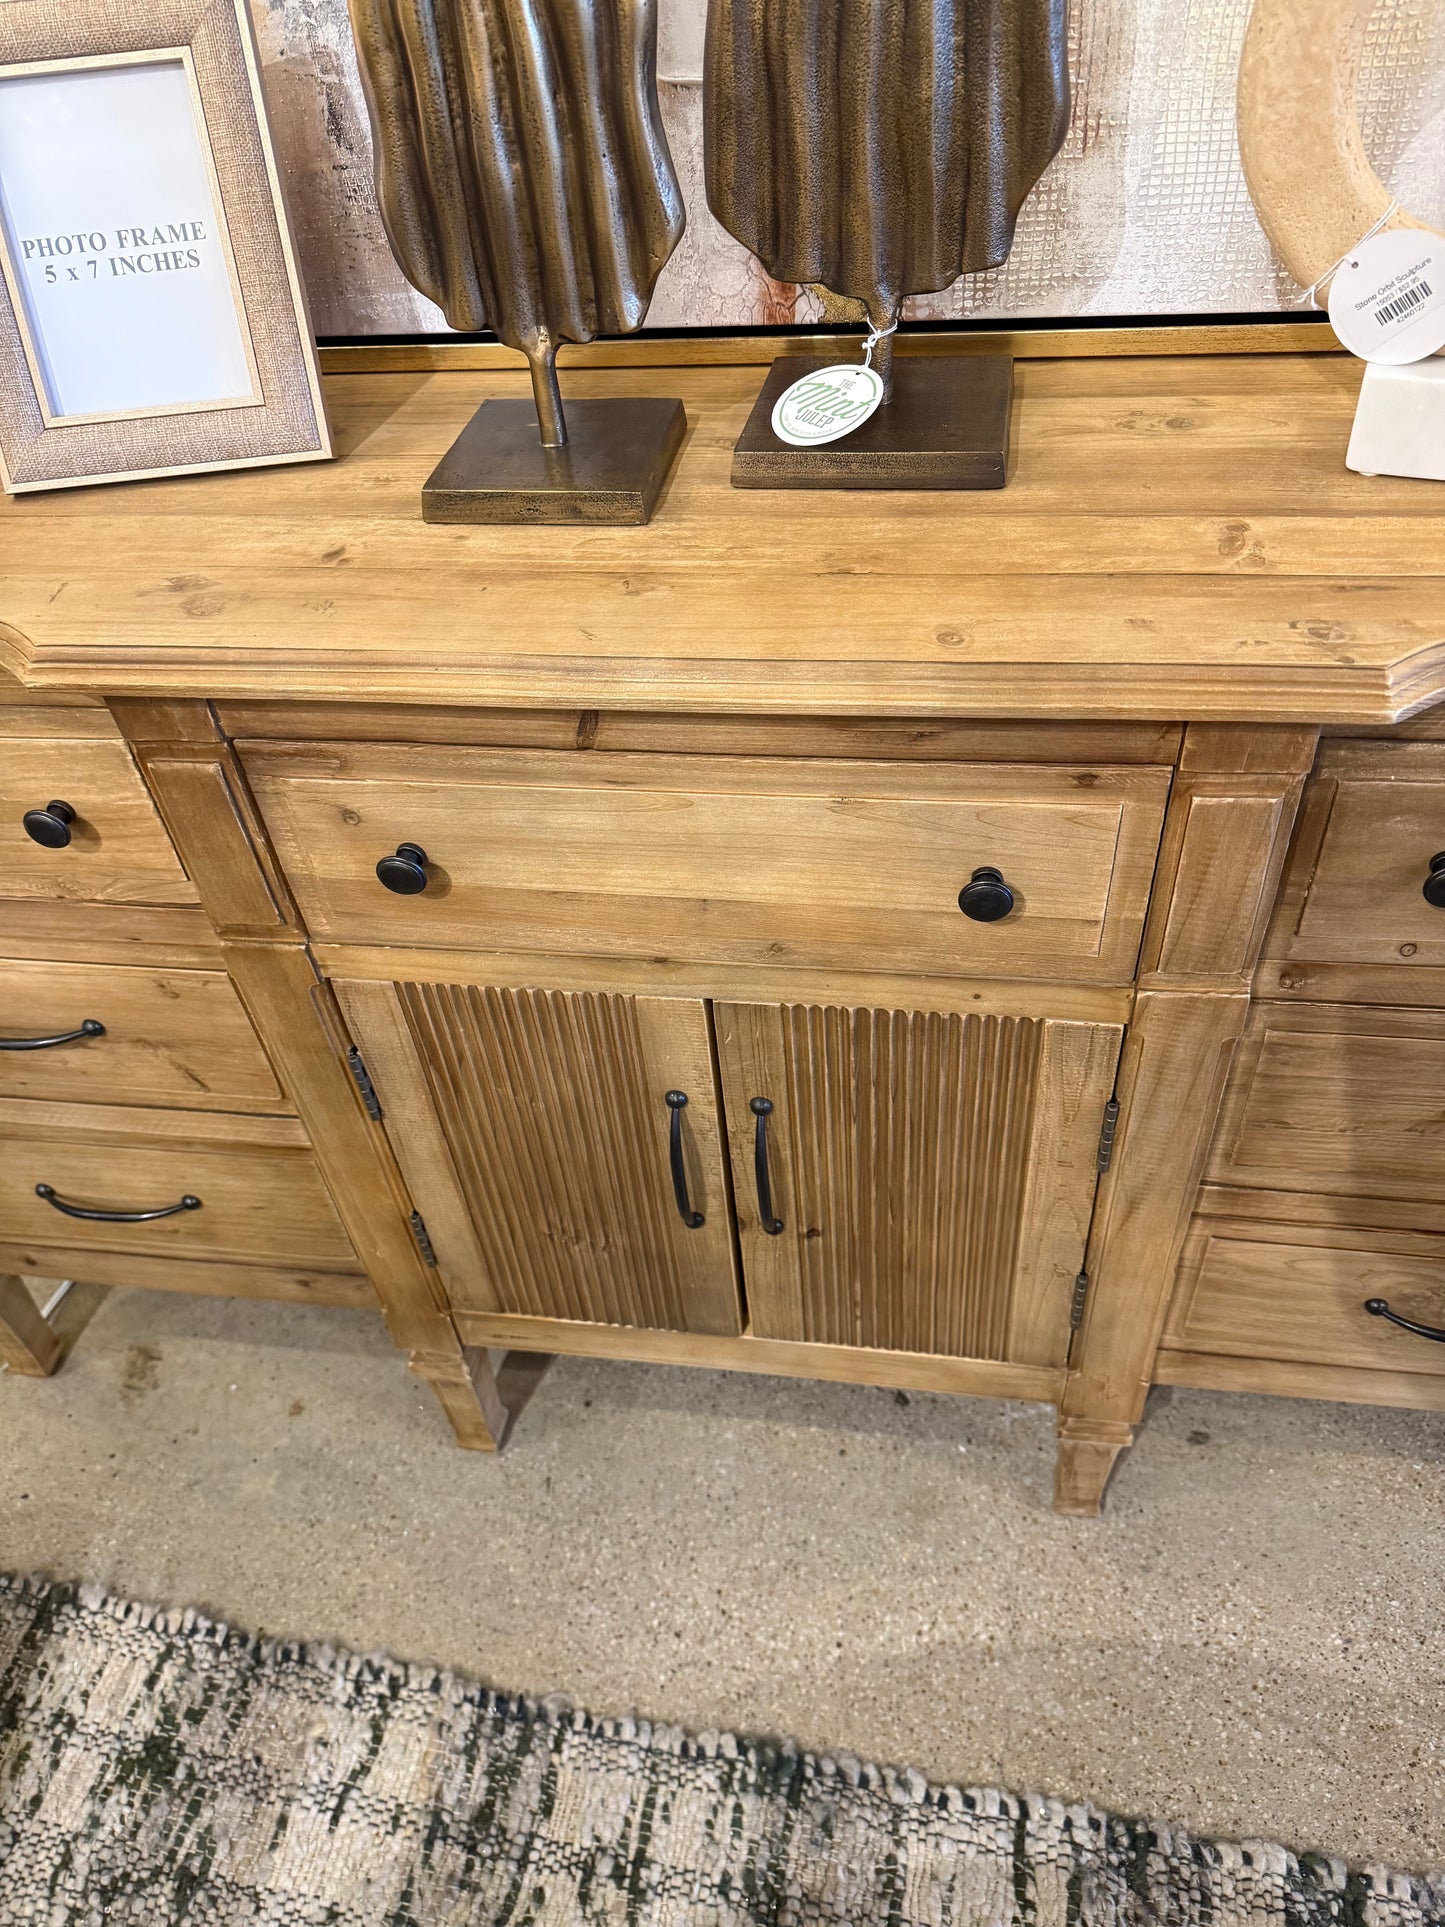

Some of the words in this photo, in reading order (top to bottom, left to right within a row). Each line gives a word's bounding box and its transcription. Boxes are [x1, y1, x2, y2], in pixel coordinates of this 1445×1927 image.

[20, 232, 107, 259] PHOTO
[115, 221, 207, 249] FRAME
[45, 264, 57, 283] 5
[66, 267, 80, 281] x
[86, 260, 97, 279] 7
[108, 249, 201, 276] INCHES
[1354, 294, 1378, 311] Stone
[1377, 281, 1397, 296] Orbit
[1395, 257, 1432, 284] Sculpture
[788, 382, 877, 420] Mint
[838, 379, 857, 390] THE
[795, 409, 835, 428] JULEP
